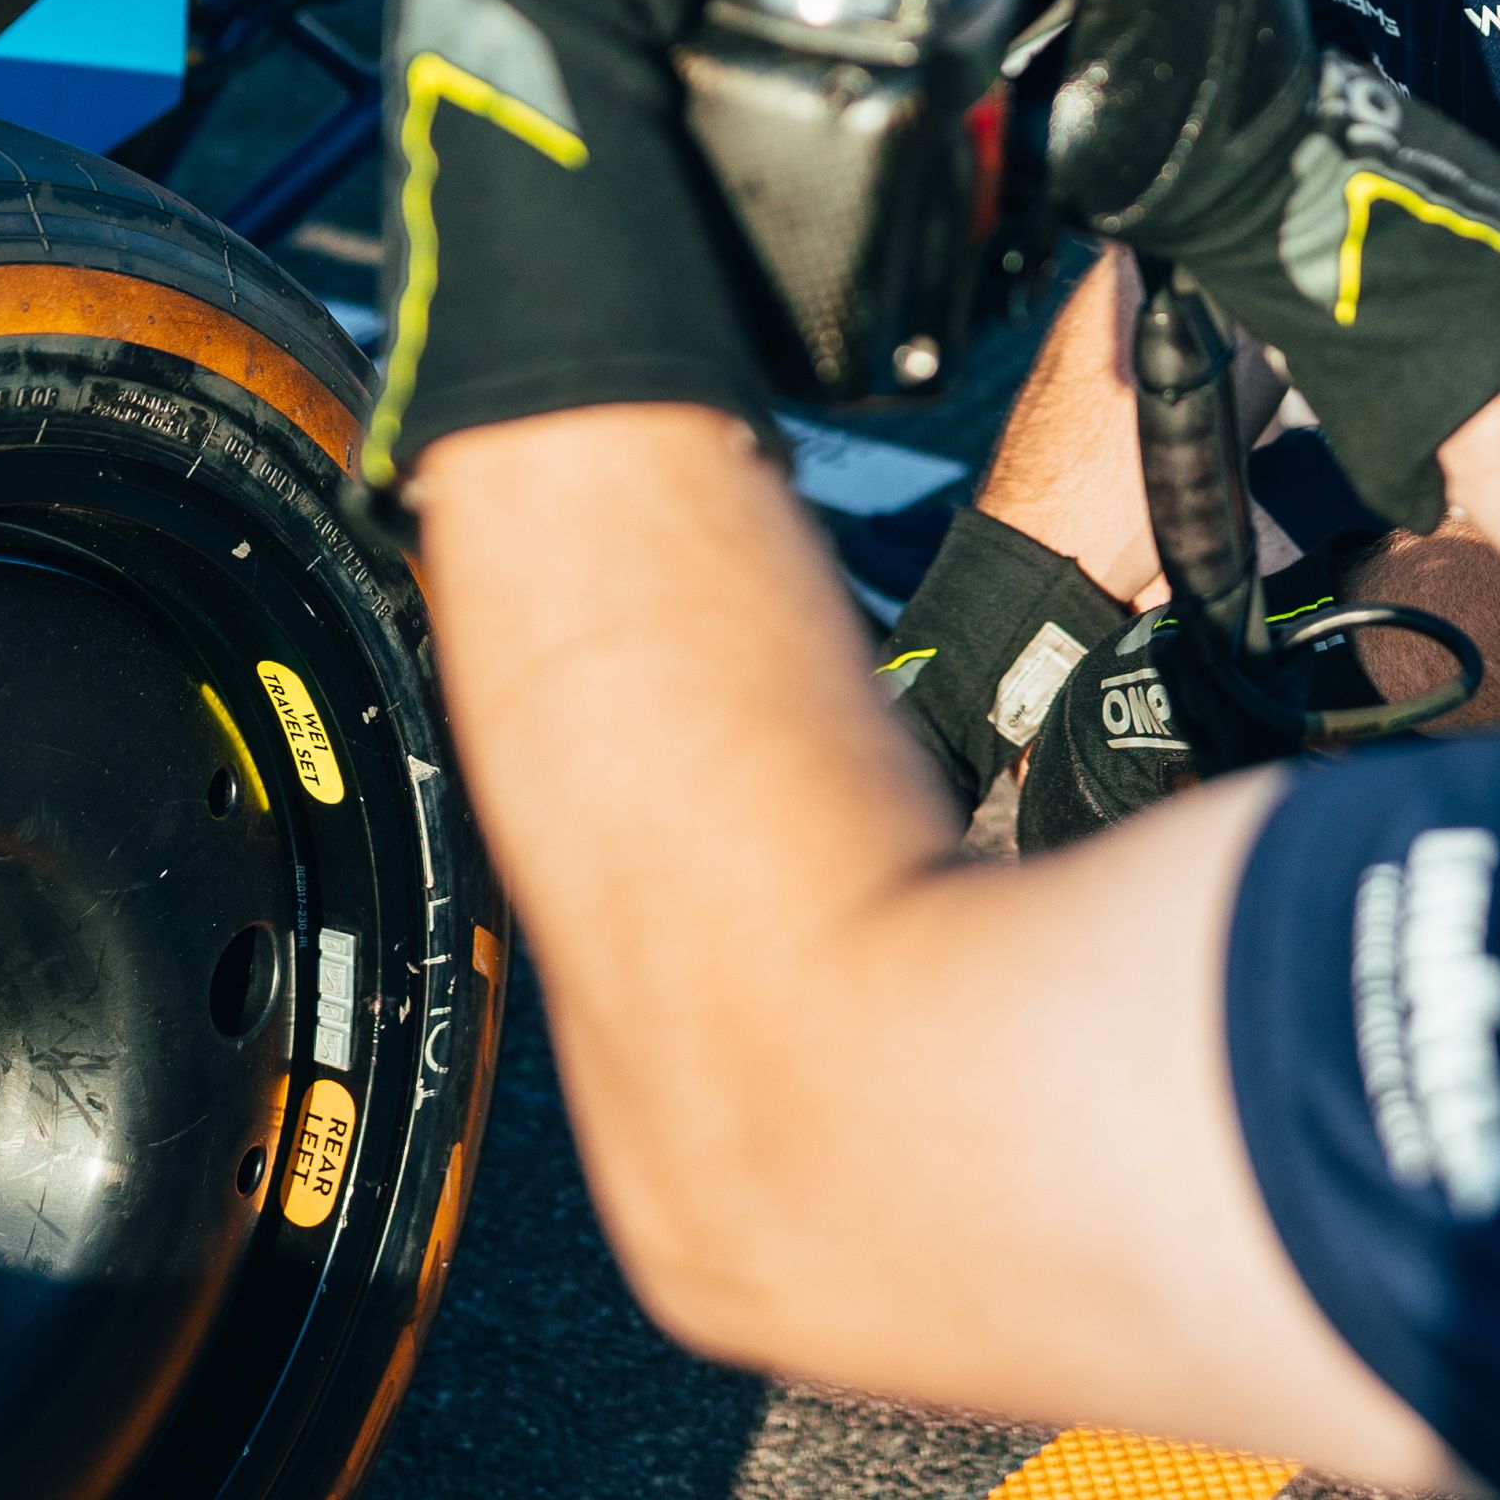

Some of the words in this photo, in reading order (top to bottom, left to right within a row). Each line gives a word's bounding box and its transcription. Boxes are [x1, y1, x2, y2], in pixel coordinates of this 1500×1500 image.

[263, 674, 305, 742] TRAVEL
[296, 747, 320, 787] SET
[1102, 683, 1173, 737] OMP
[290, 1111, 323, 1187] LEFT
[312, 1116, 348, 1198] REAR
